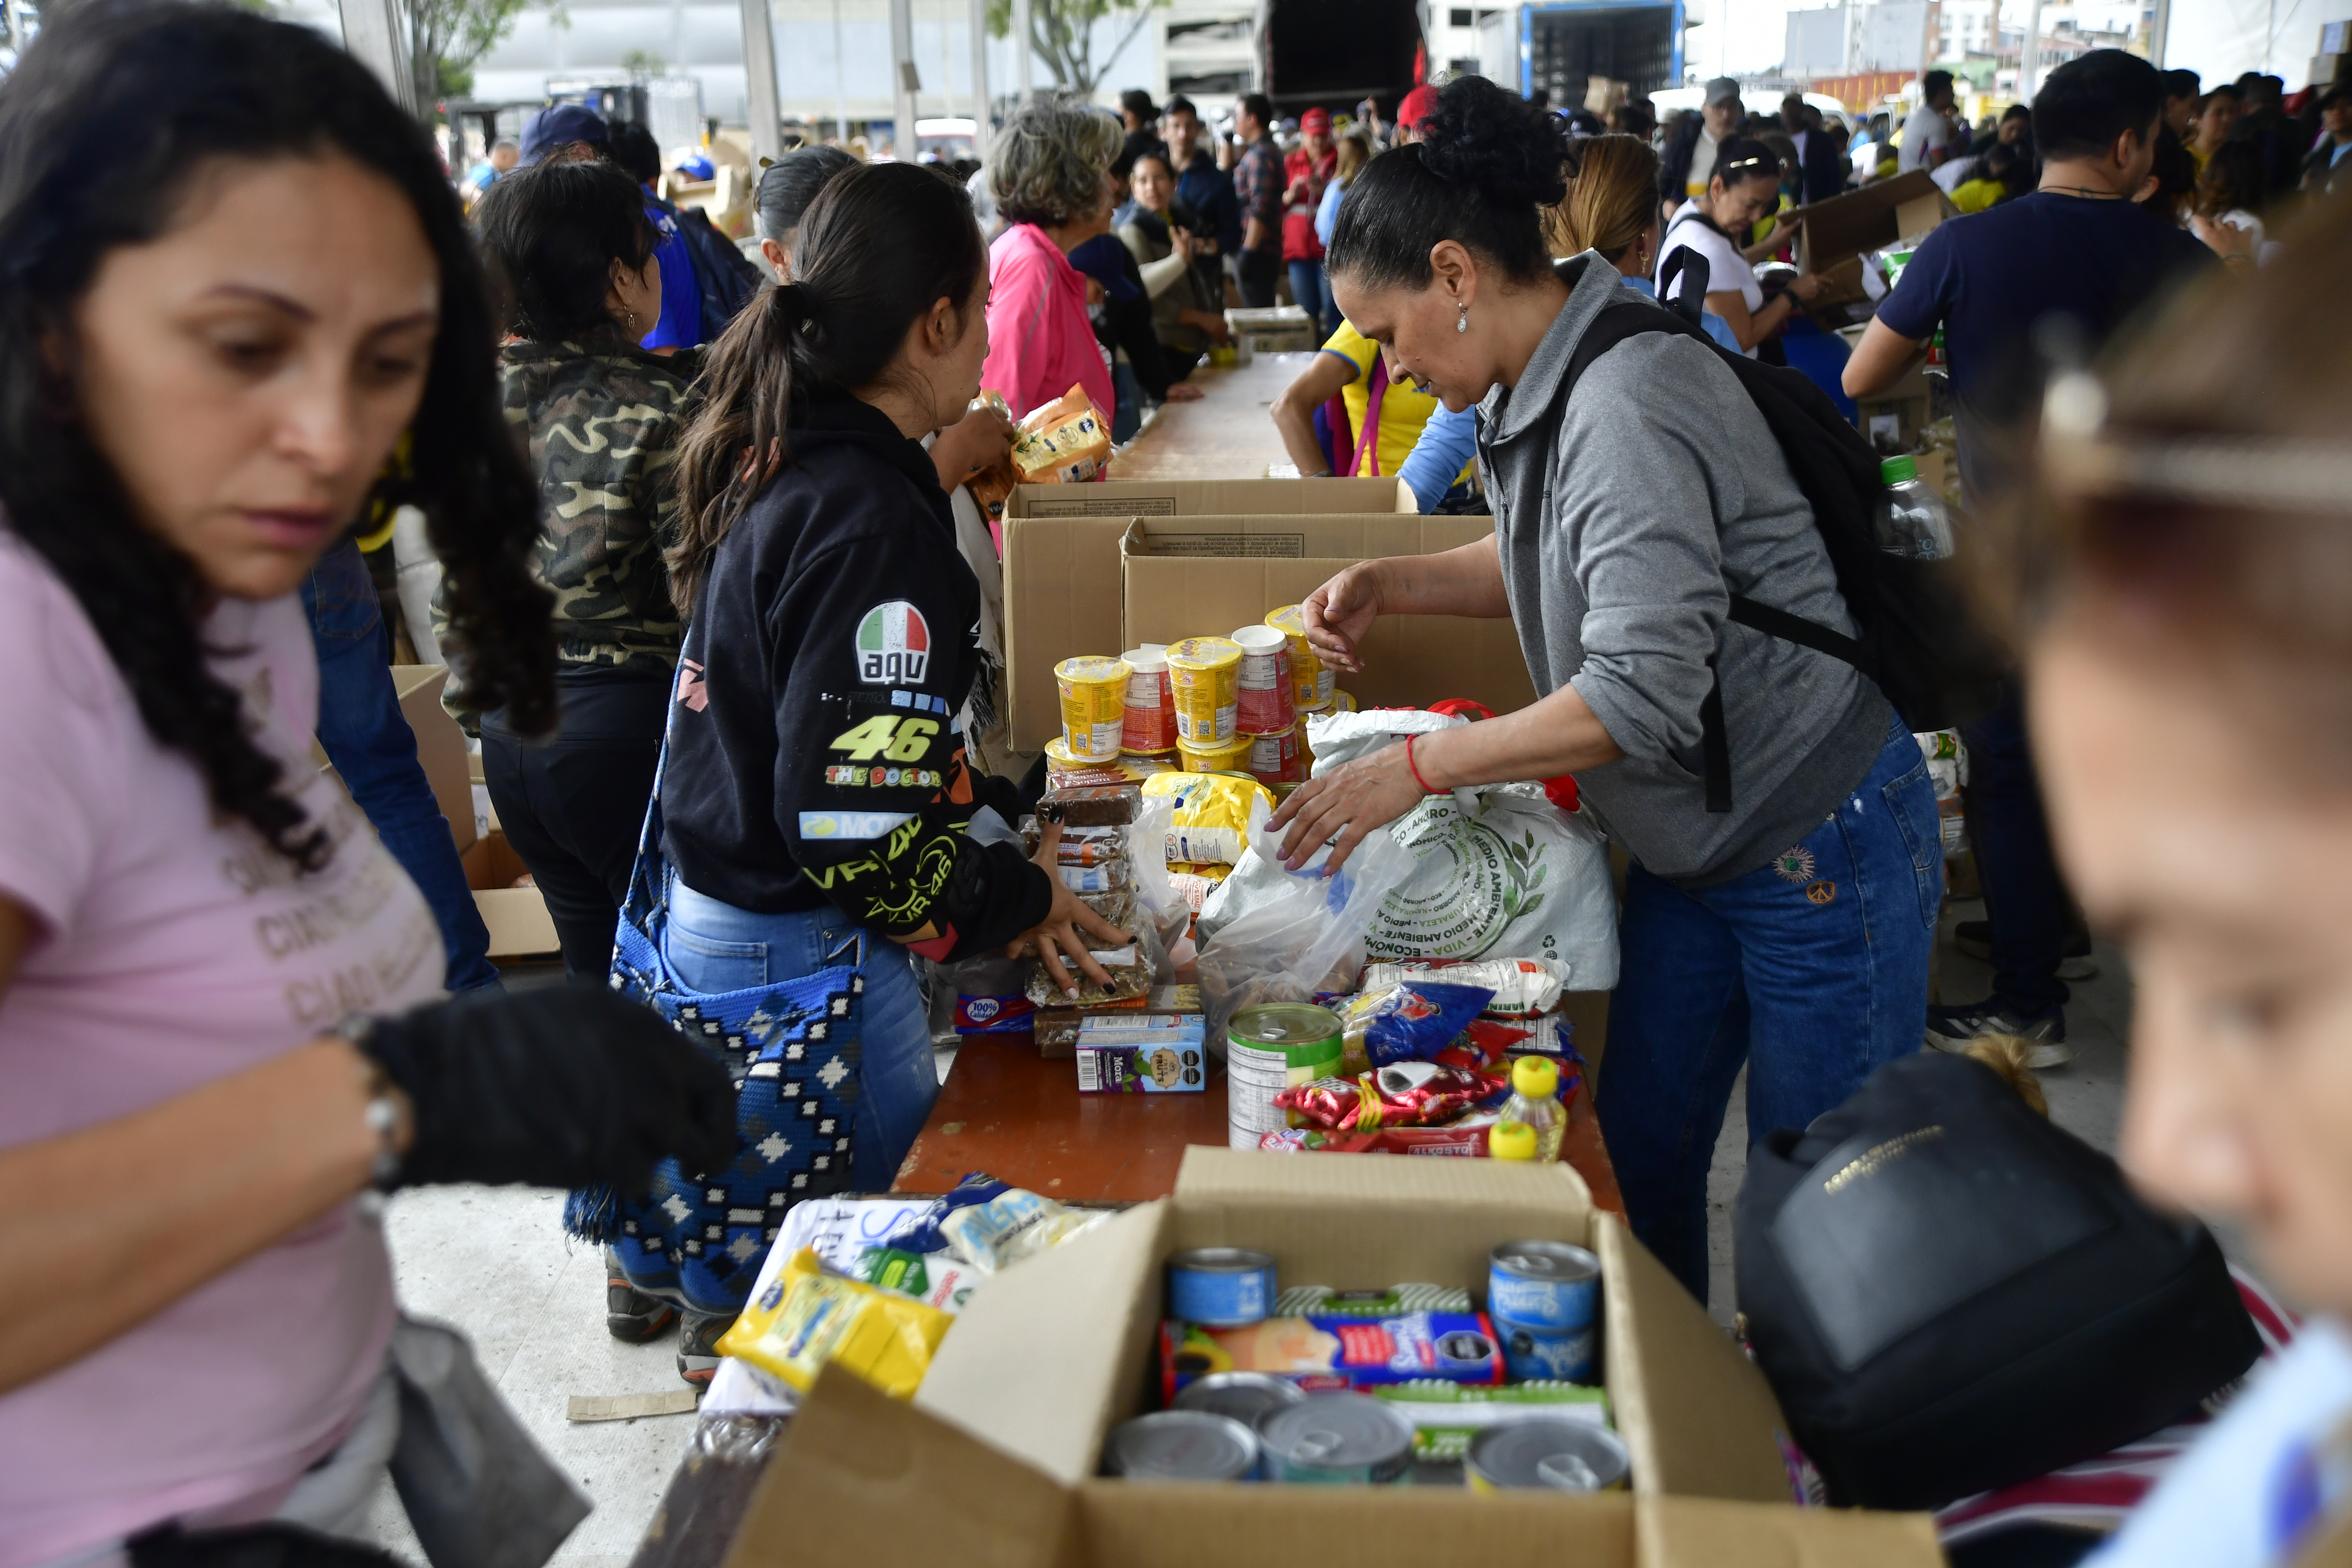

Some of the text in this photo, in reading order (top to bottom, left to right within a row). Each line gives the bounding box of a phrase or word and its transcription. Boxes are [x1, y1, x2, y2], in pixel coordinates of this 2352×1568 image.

[829, 715, 939, 762] 46
[825, 765, 942, 788] THE DOCTOR
[1071, 777, 1111, 785] Sopera
[1395, 830, 1407, 844] CO
[1473, 835, 1498, 869] MEDIO
[1430, 891, 1443, 901] ECO
[1384, 915, 1412, 927] MEDIO
[1384, 931, 1441, 942] AMBIENTE
[1364, 935, 1421, 957] ECONÓM
[1432, 939, 1467, 956] VIDA
[972, 1002, 997, 1012] 100%
[1113, 1056, 1124, 1083] Mora
[1155, 1054, 1164, 1082] FRUTS
[1413, 1146, 1469, 1156] ALKOSTO
